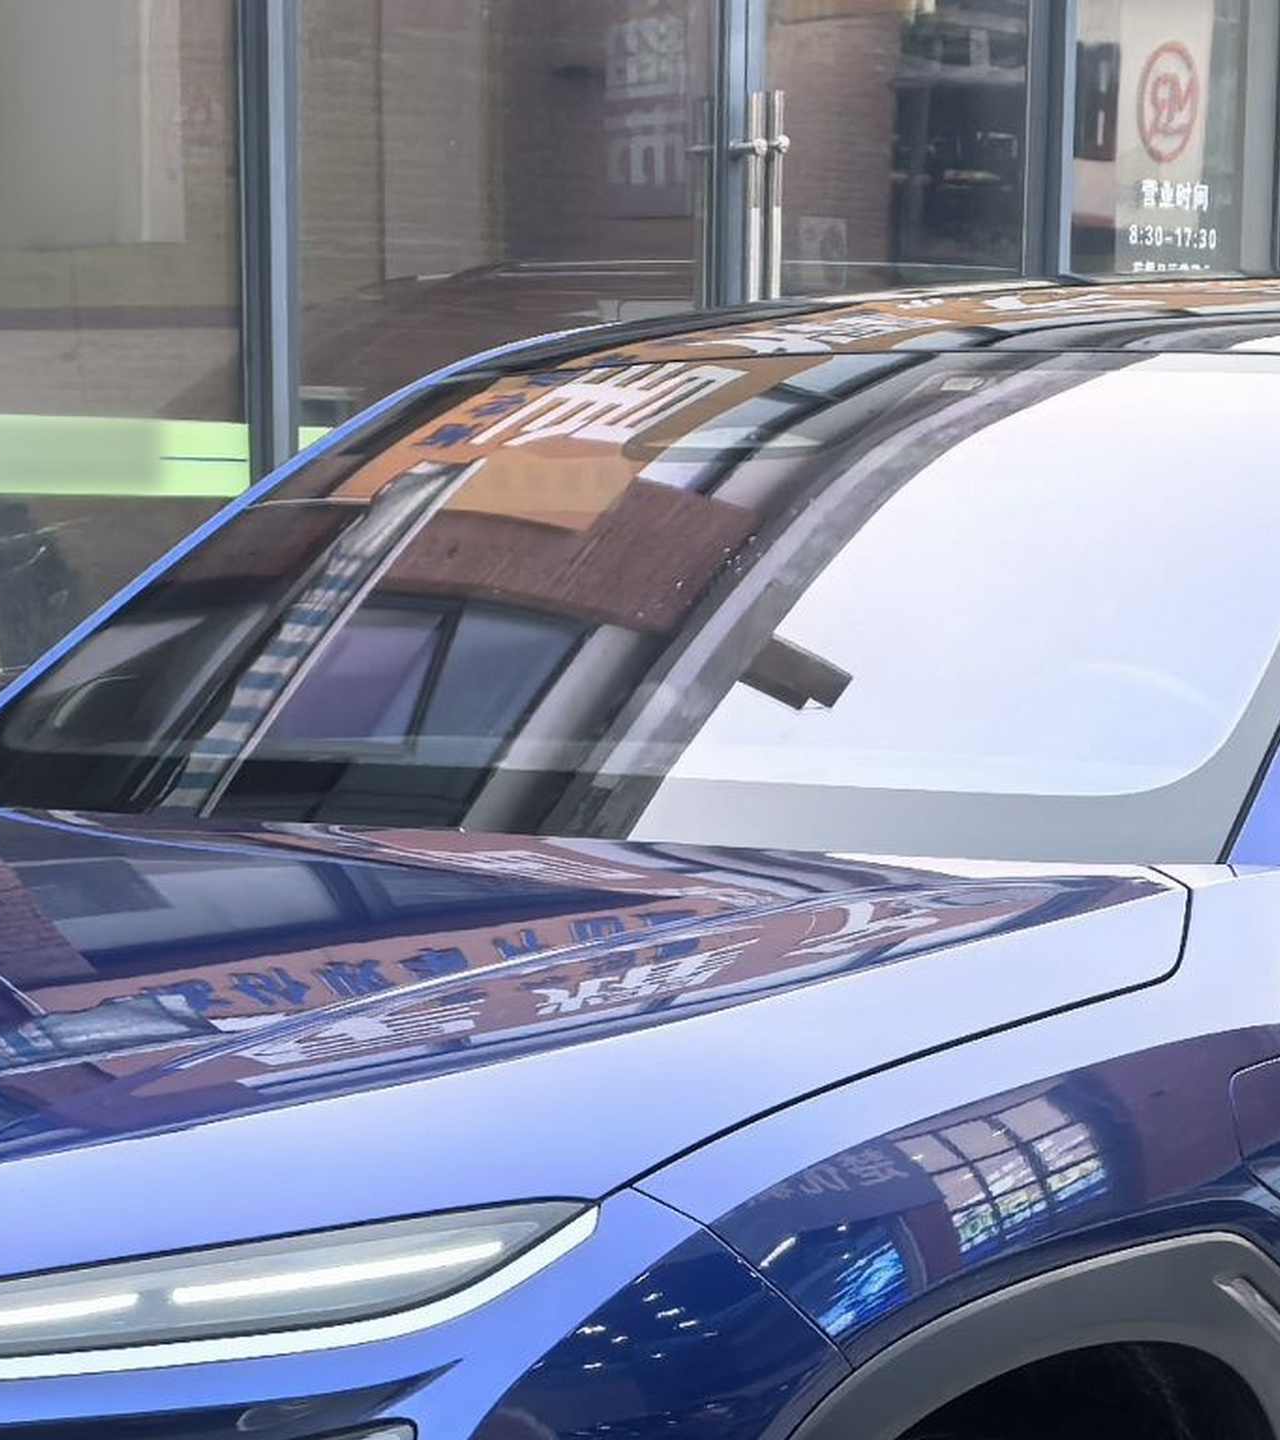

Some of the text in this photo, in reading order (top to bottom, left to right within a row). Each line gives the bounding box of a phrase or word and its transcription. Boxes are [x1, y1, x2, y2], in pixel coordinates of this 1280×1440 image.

[1141, 179, 1209, 211] 营业时间
[1128, 224, 1217, 250] 8:30-17:30
